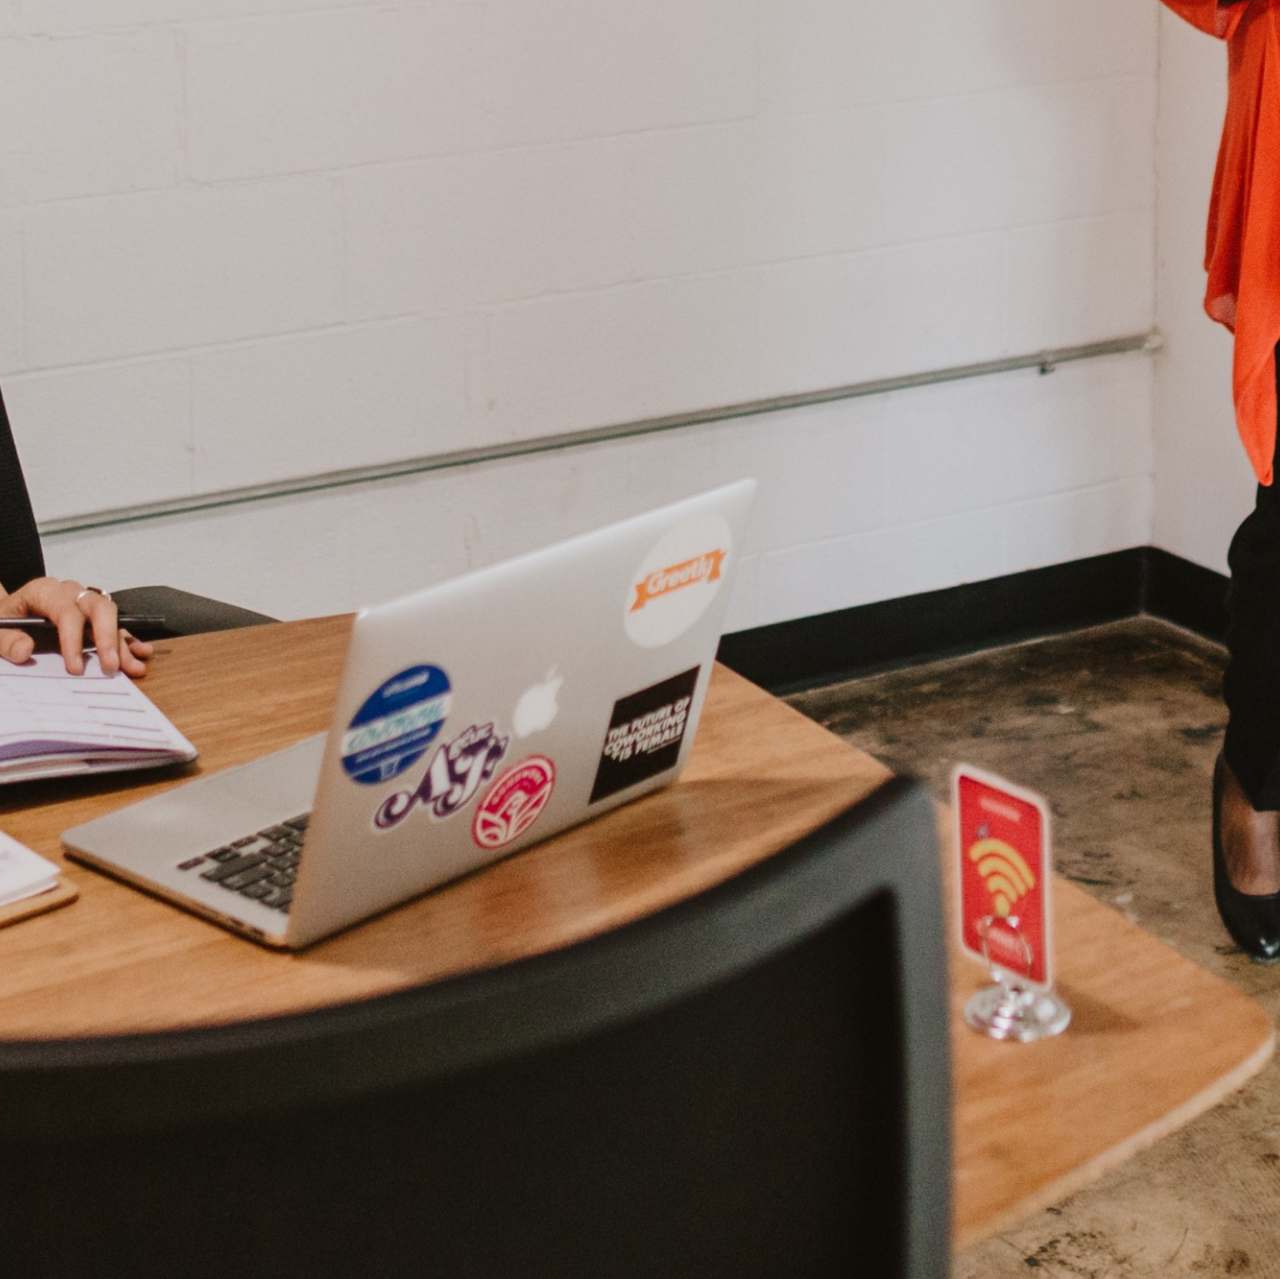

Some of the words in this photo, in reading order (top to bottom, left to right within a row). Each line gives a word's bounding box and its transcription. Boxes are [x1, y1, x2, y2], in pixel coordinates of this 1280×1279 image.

[604, 710, 687, 756] COWORKING
[608, 723, 630, 742] THE
[634, 721, 684, 756] FEMALE
